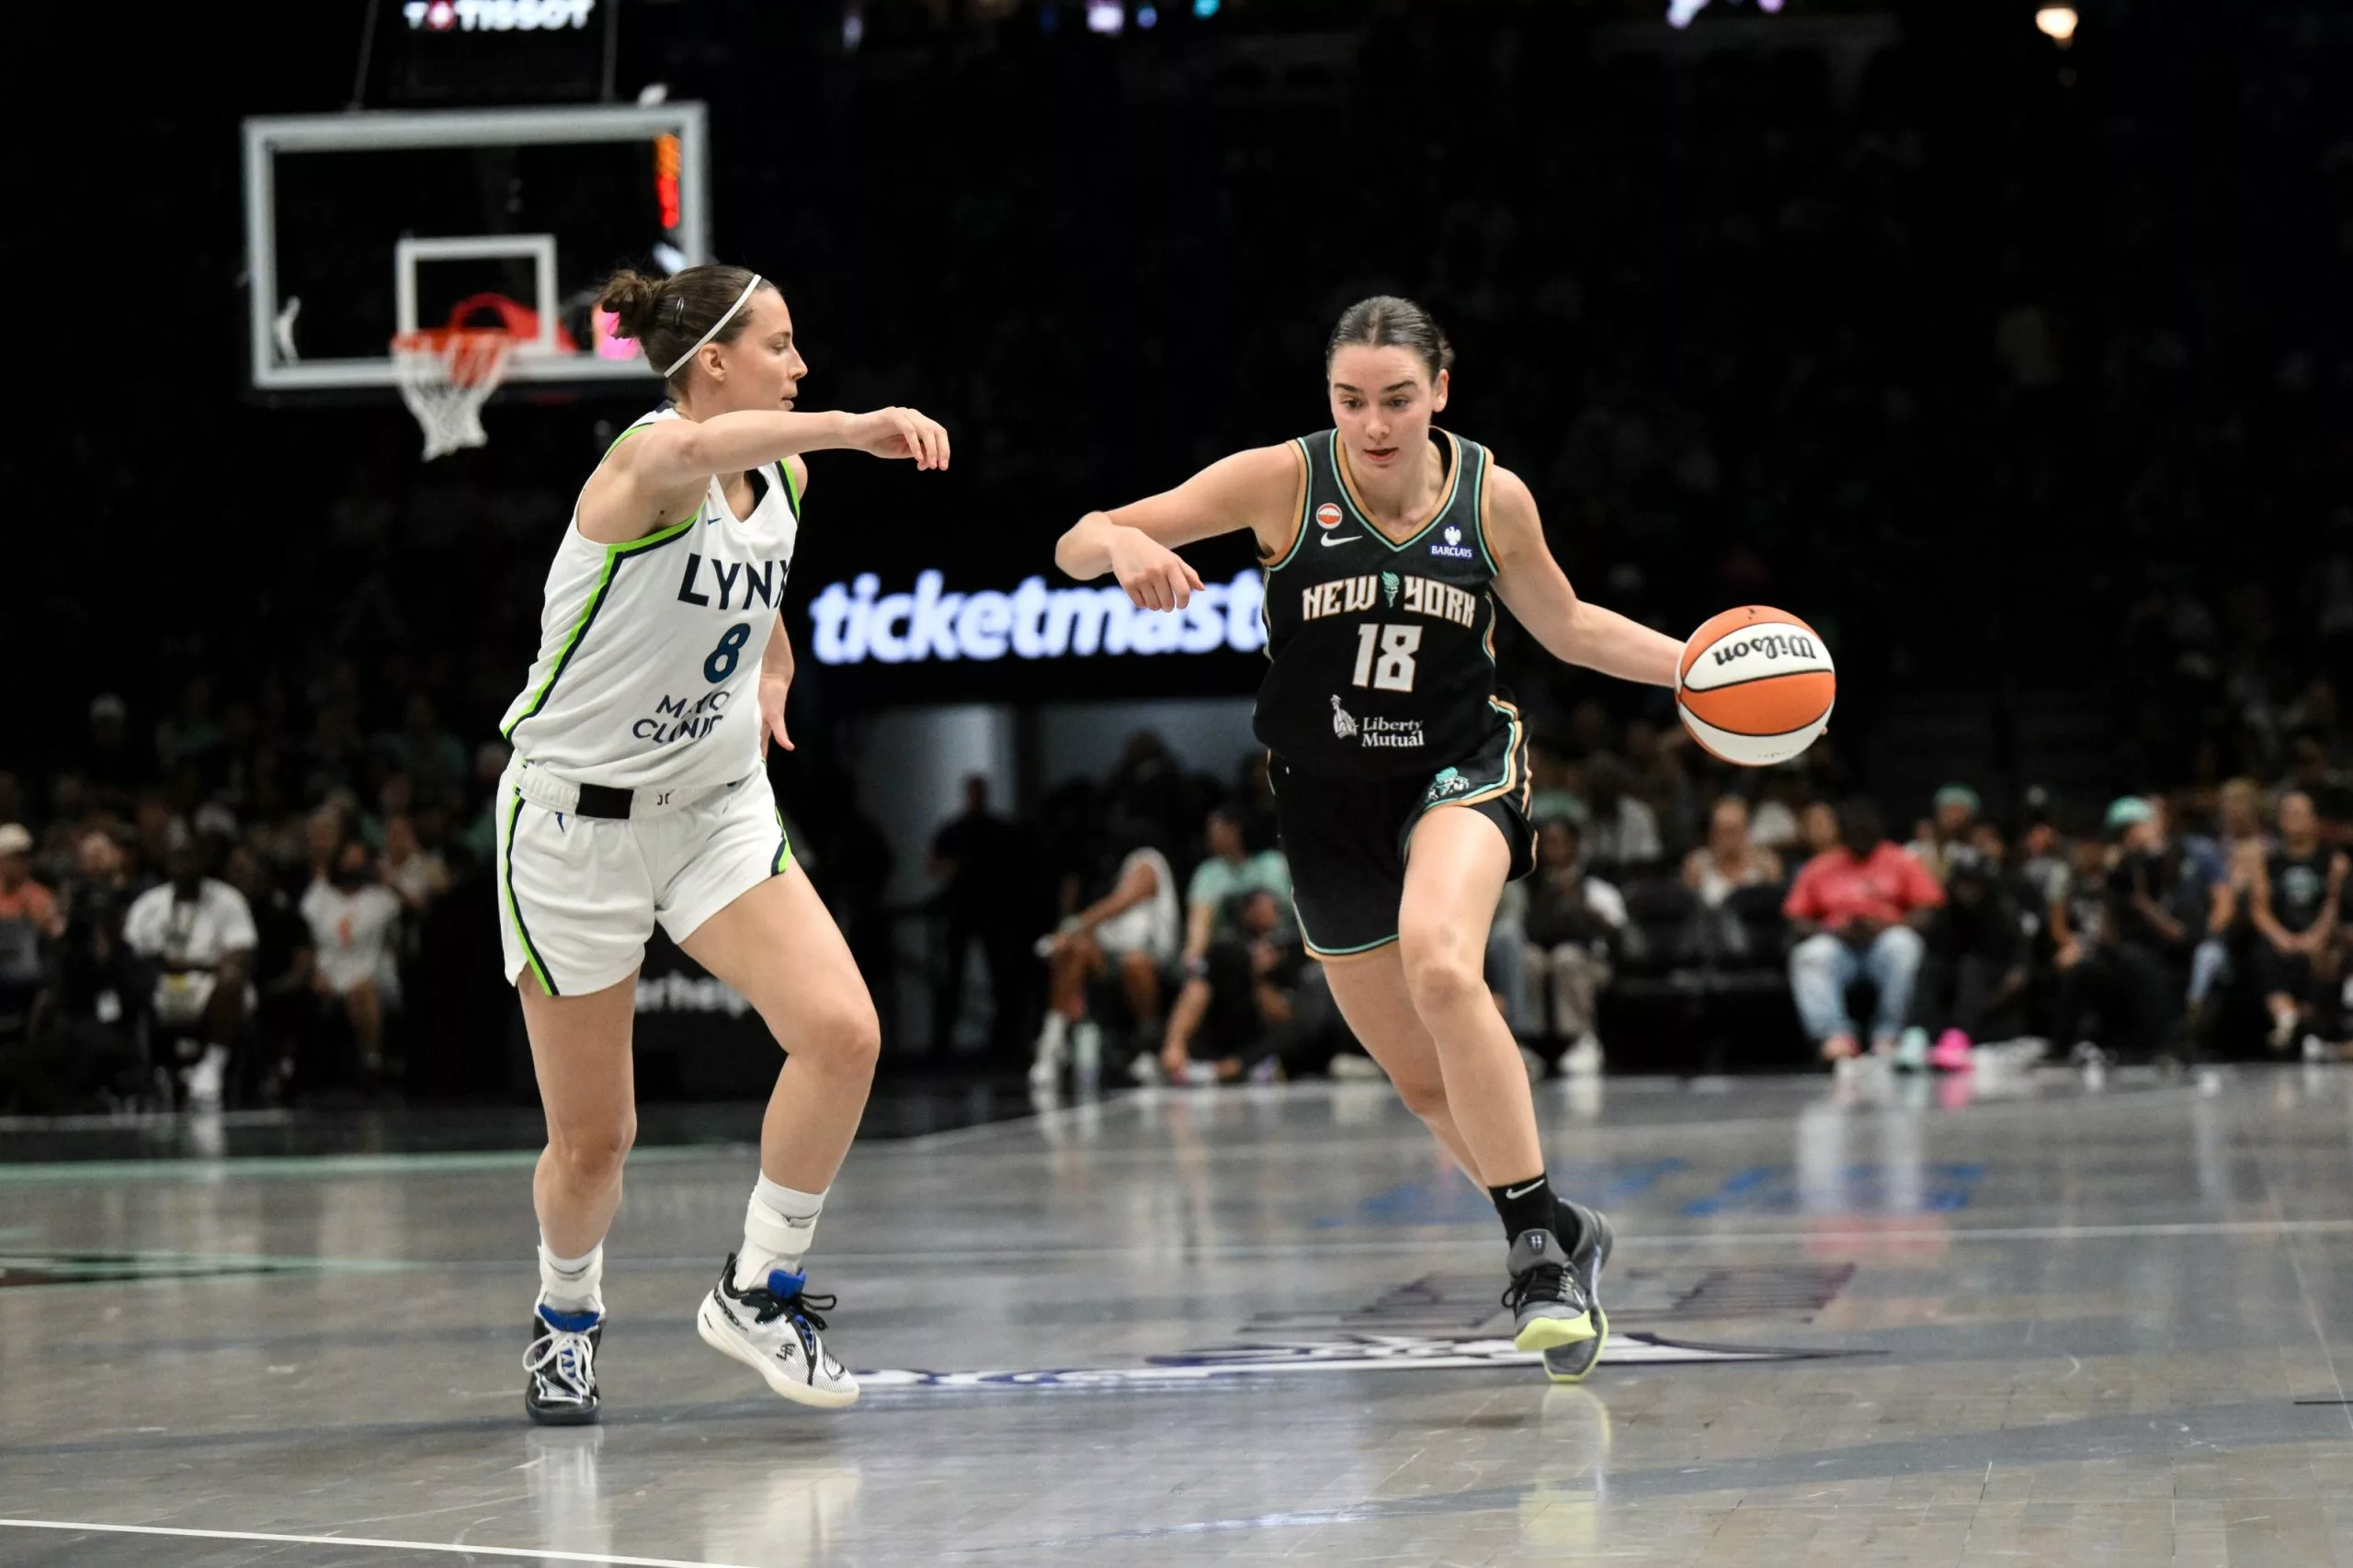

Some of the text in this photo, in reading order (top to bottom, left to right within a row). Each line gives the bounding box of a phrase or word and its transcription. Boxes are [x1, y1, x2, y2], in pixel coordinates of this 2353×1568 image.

[455, 0, 596, 31] TISSOT
[1431, 545, 1472, 558] BARCLAYS
[809, 569, 1268, 665] ticketmast
[1302, 574, 1476, 629] NEW YORK
[703, 622, 751, 684] 8
[1352, 623, 1424, 692] 18
[1713, 634, 1817, 666] Wilson
[655, 691, 730, 718] MYO
[1361, 731, 1425, 748] Mutual
[1363, 717, 1424, 733] Liberty
